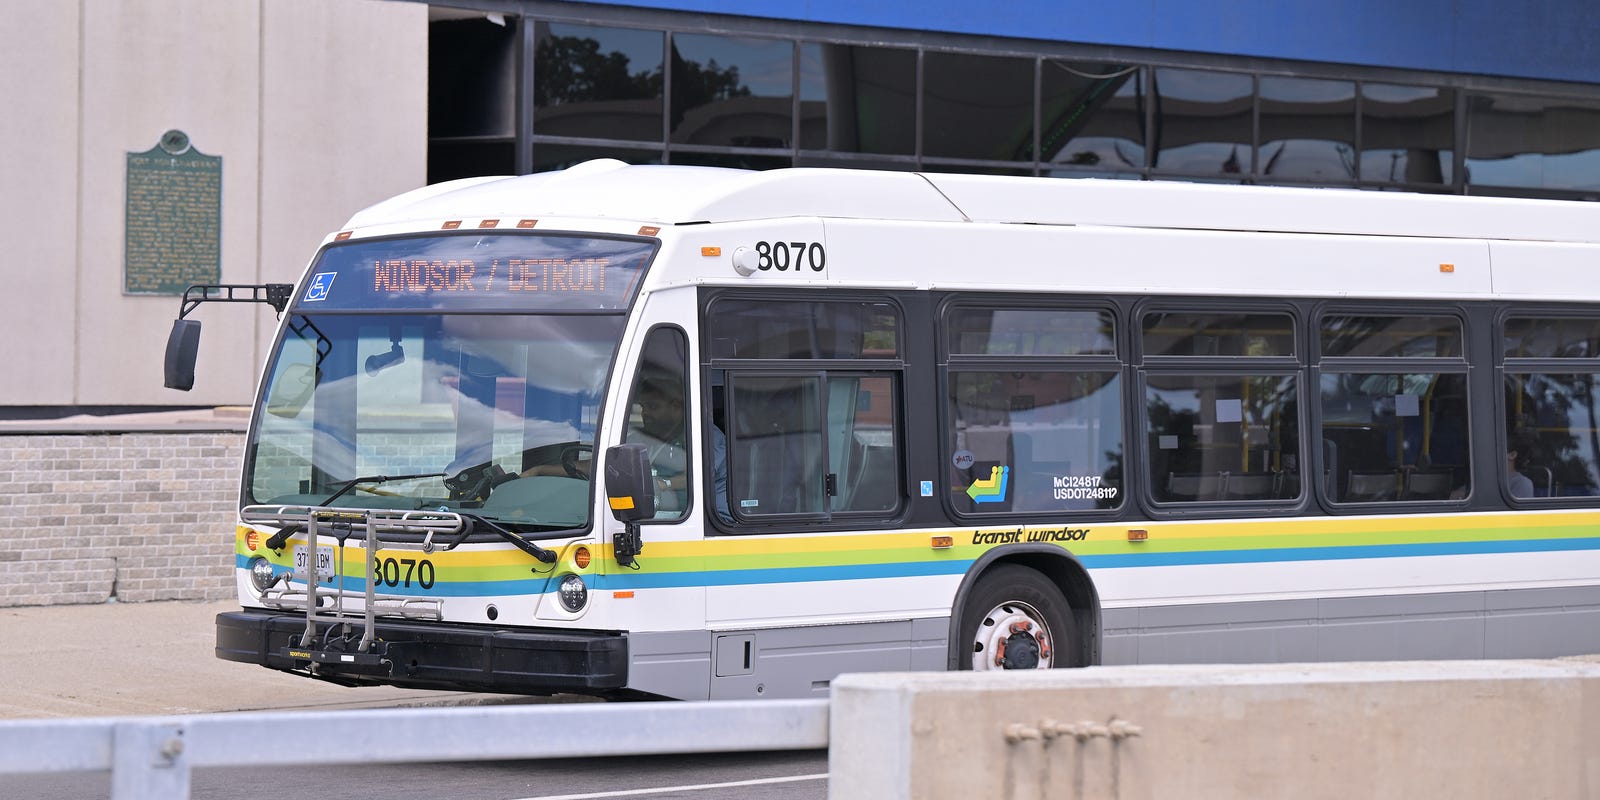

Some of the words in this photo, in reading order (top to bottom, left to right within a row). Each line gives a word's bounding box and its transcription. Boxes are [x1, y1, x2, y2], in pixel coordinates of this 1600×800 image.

[755, 241, 826, 272] 8070
[375, 259, 475, 292] WINDSOR
[486, 259, 498, 291] /
[508, 258, 609, 292] DETROIT
[972, 528, 1023, 545] transit
[1027, 527, 1090, 542] windsor
[296, 552, 309, 567] 37
